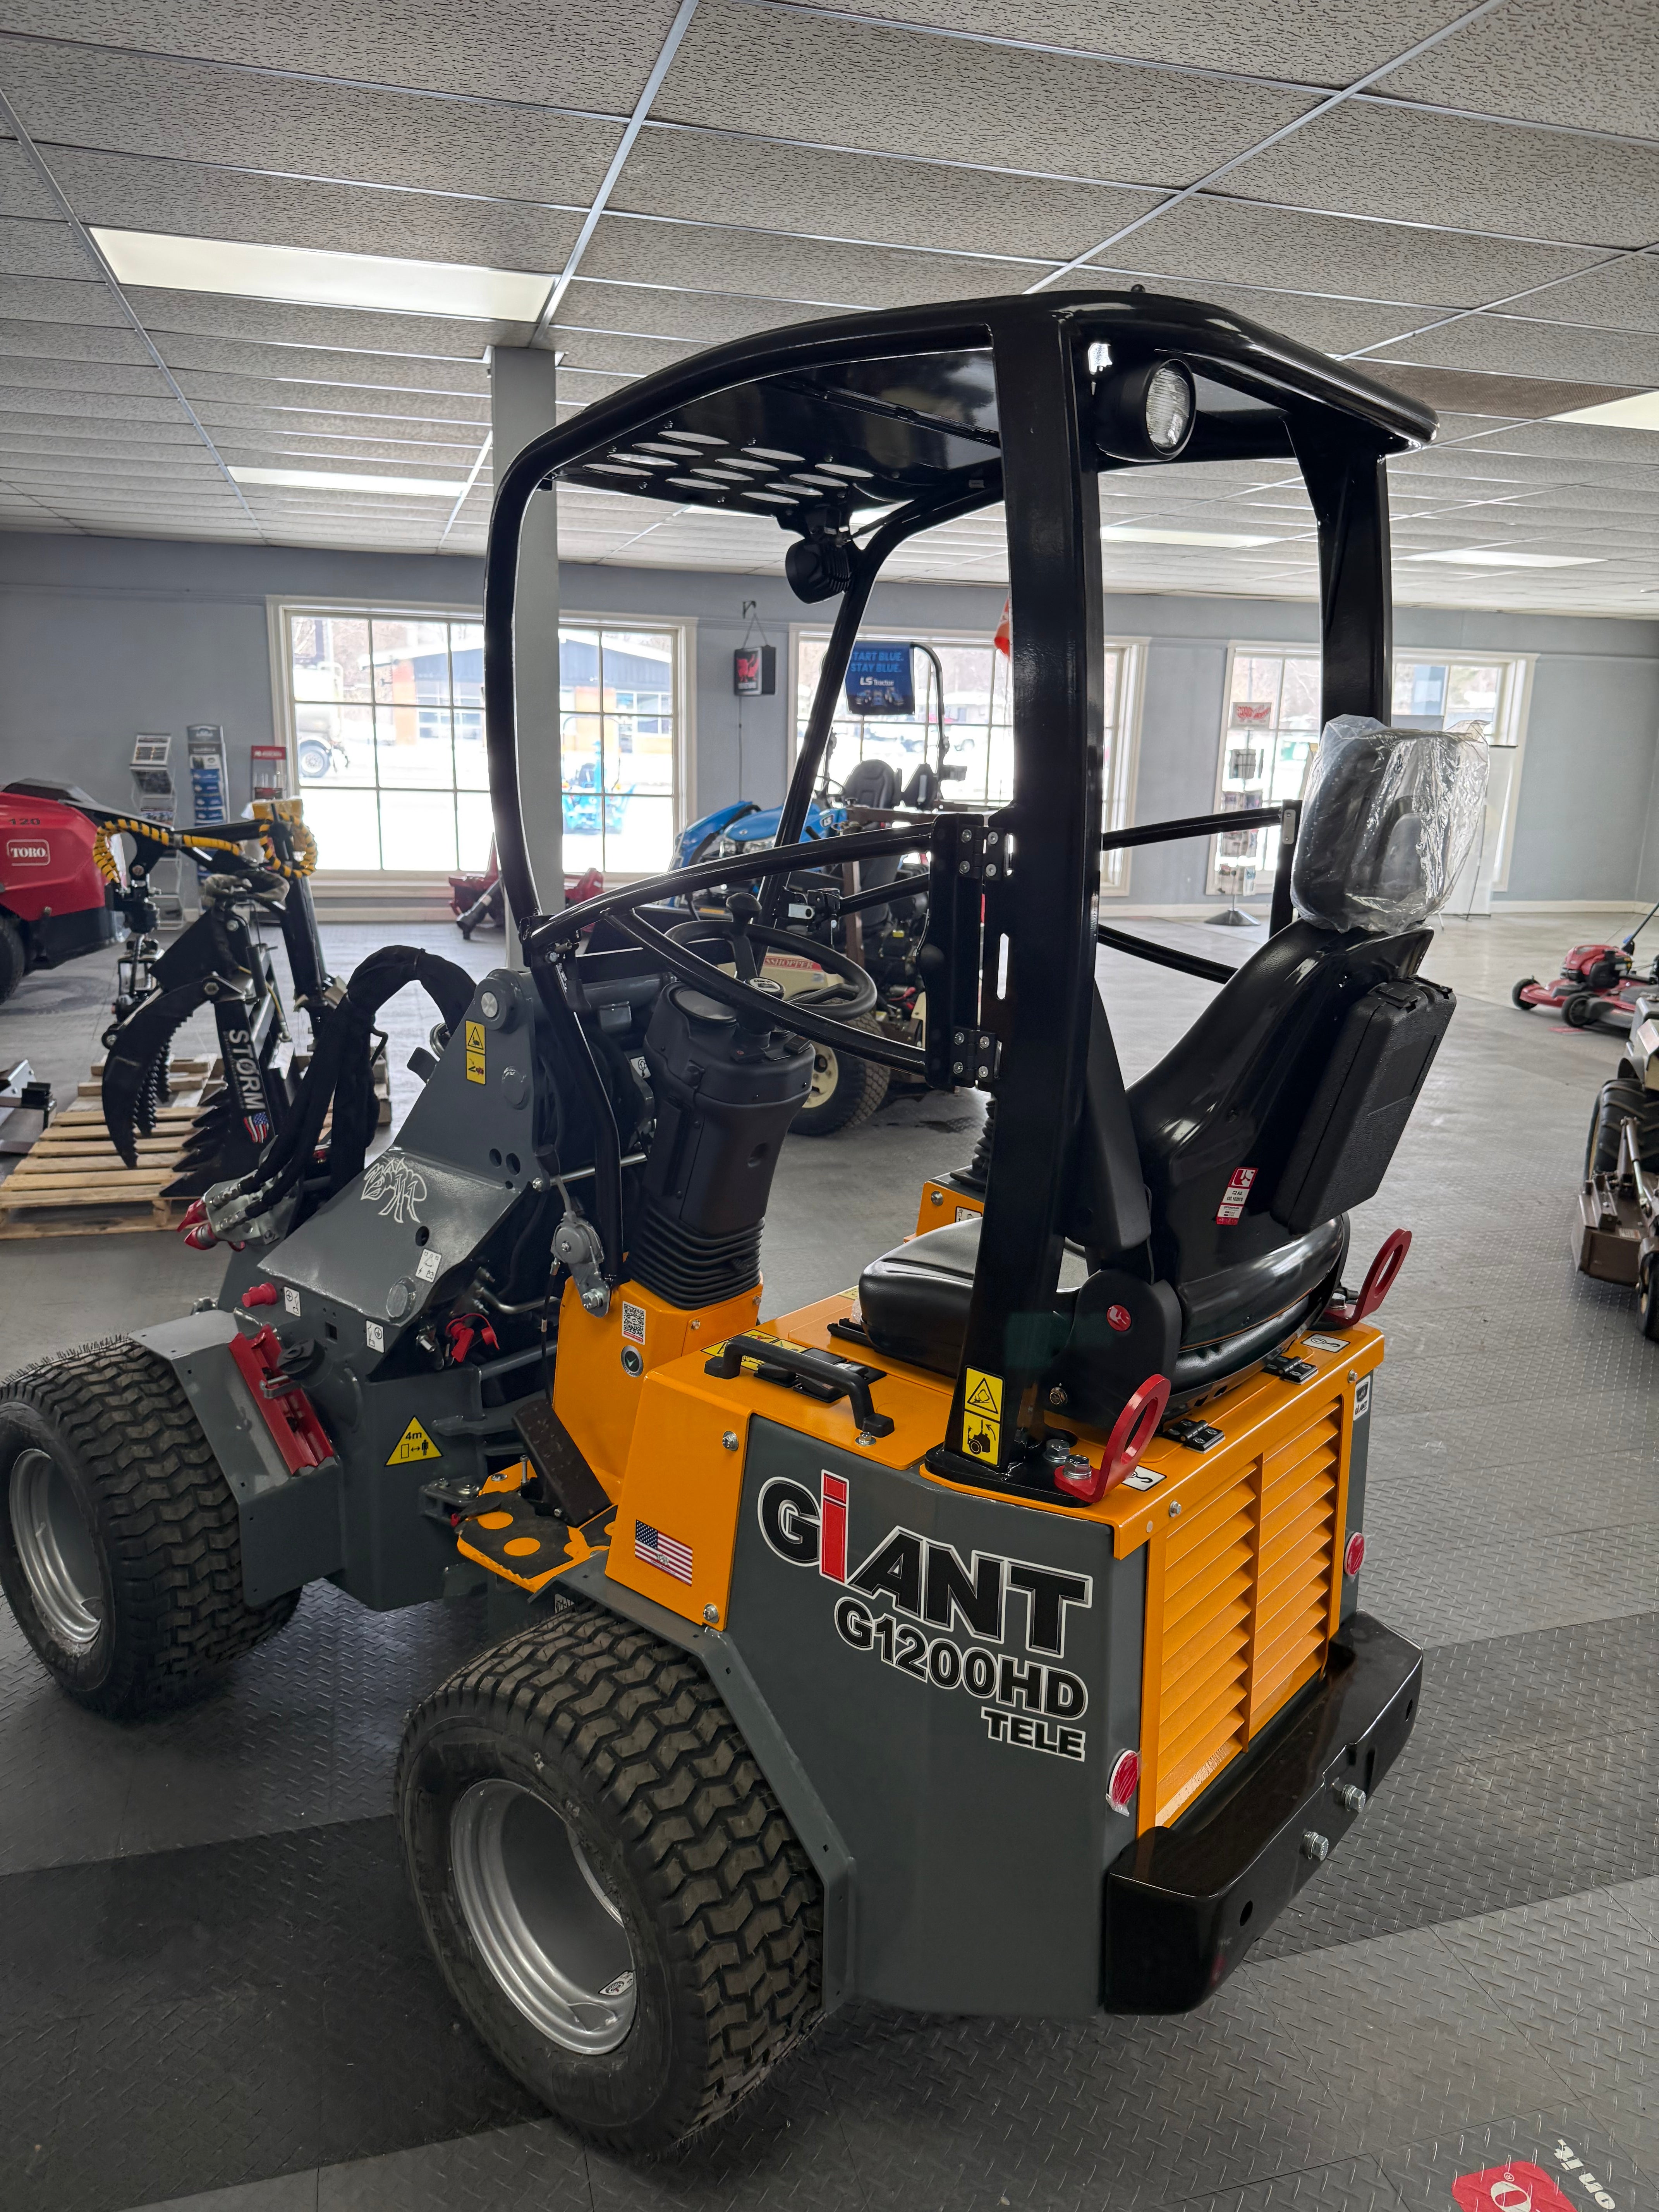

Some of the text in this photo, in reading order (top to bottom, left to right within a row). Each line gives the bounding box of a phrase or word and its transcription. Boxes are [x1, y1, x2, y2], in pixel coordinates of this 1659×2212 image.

[853, 652, 877, 661] TART
[851, 663, 875, 672] STAY
[860, 676, 873, 685] LS
[10, 847, 46, 857] TORO
[765, 958, 813, 969] SSHOPPER
[834, 1596, 1089, 1720] G1200HD
[981, 1706, 1086, 1762] TELE
